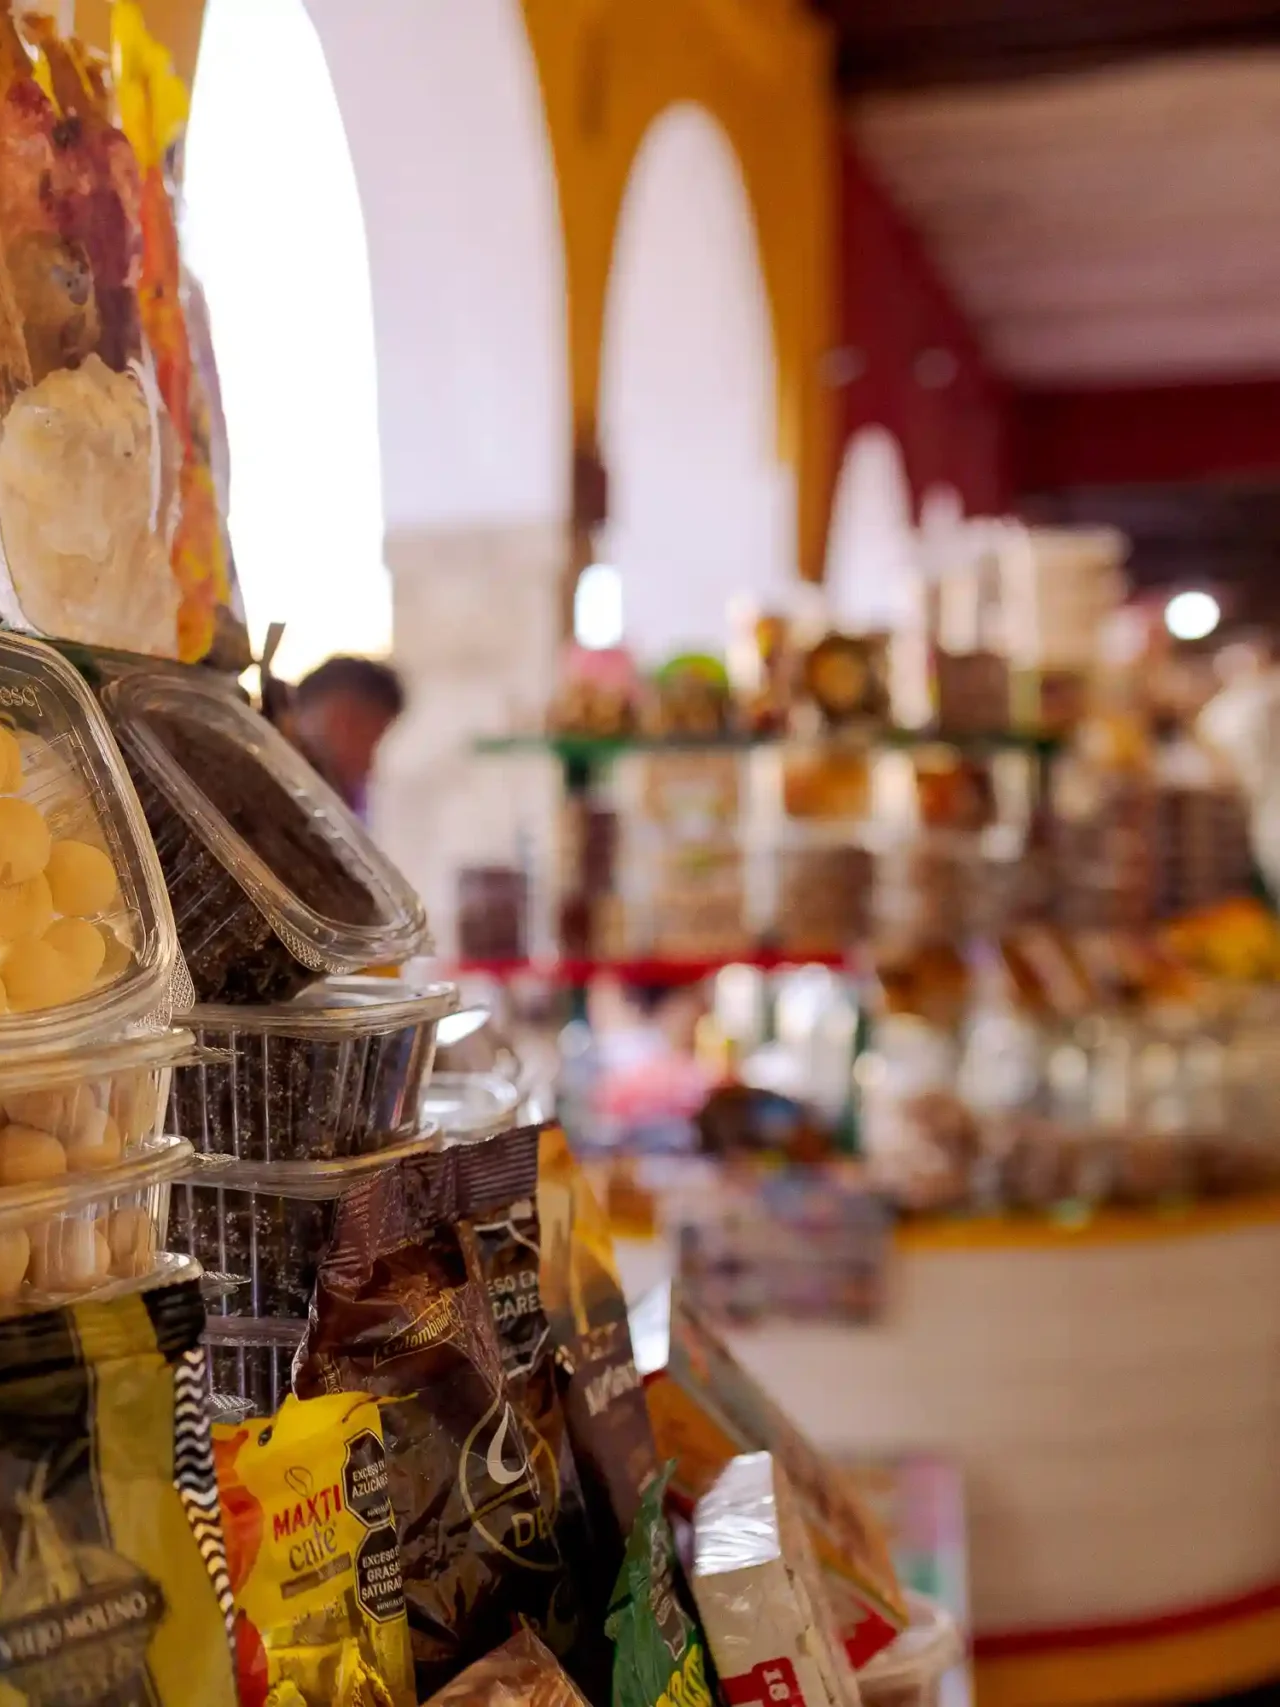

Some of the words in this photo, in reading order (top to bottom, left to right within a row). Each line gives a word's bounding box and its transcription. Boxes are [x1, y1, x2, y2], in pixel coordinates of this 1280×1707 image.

[492, 1292, 544, 1320] CARE
[352, 1463, 378, 1482] EXCESO
[273, 1484, 342, 1543] MAXTI
[362, 1548, 394, 1569] EXCESO
